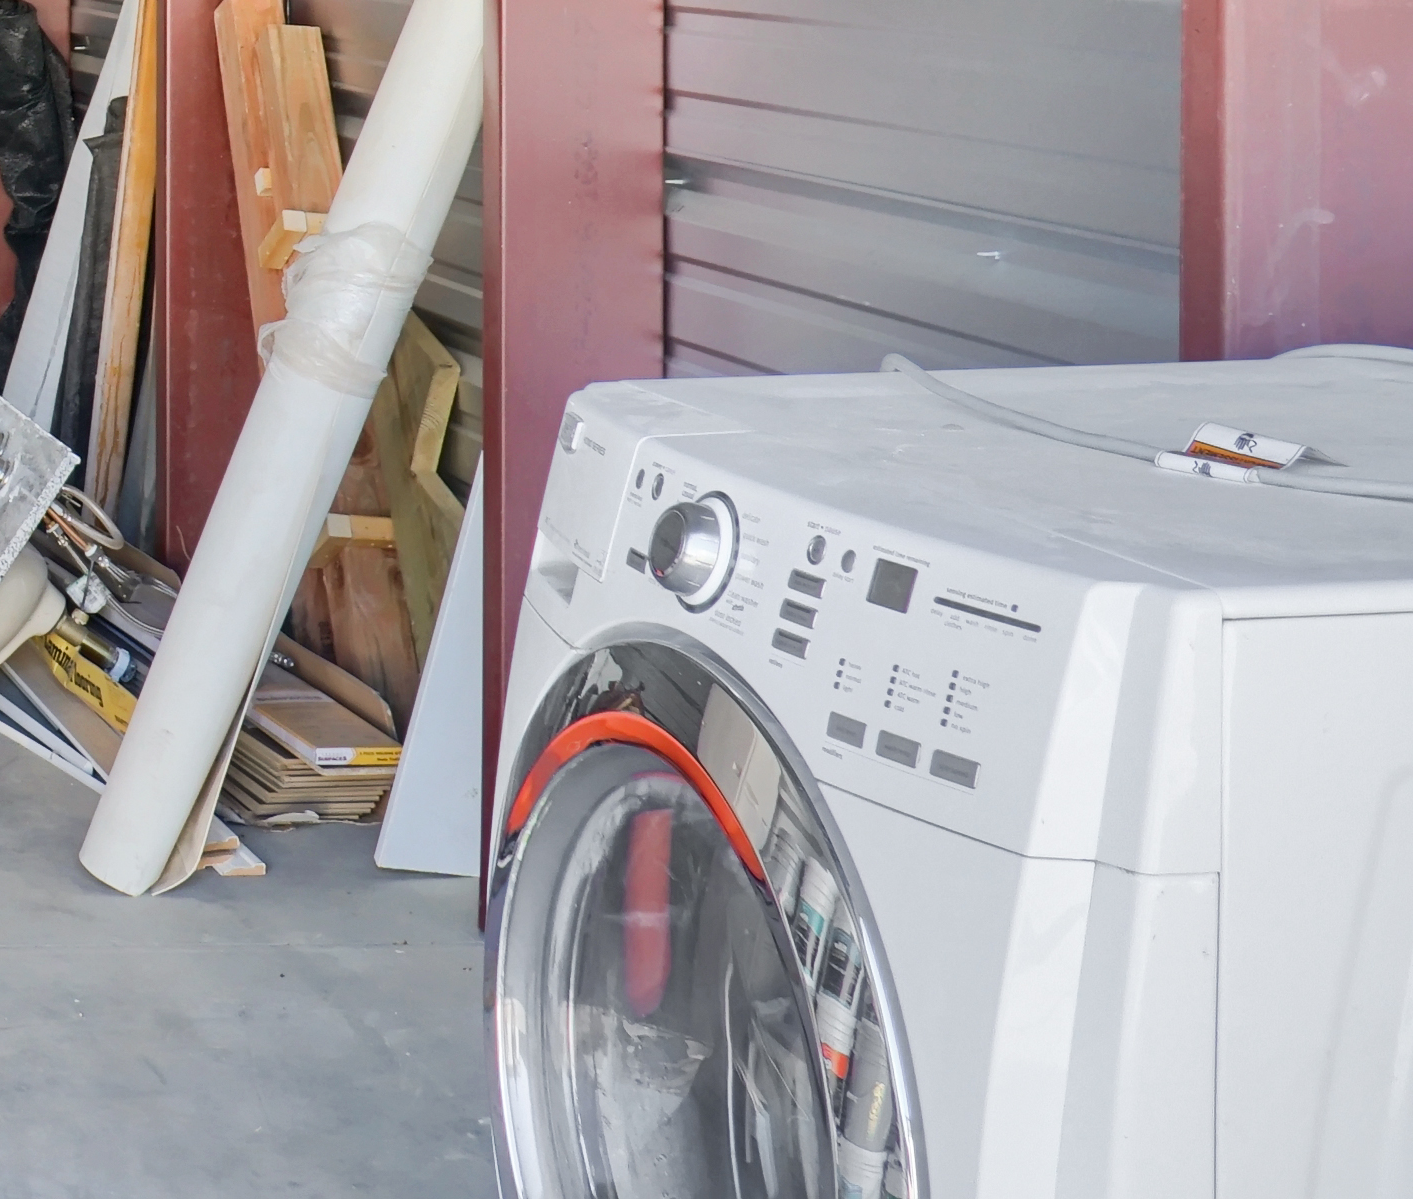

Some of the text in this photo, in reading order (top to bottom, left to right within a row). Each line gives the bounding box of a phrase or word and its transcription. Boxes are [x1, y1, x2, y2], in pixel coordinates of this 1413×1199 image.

[807, 520, 842, 536] start pause
[873, 544, 931, 568] estimated time remaining
[946, 587, 1008, 609] sensing estimated time
[965, 618, 979, 627] wash
[1002, 629, 1014, 638] spin
[962, 675, 991, 690] extra high
[908, 684, 923, 693] warm
[923, 688, 937, 698] rinse
[959, 686, 972, 696] high
[906, 695, 921, 704] warm
[955, 699, 979, 711] medium
[953, 710, 964, 720] low
